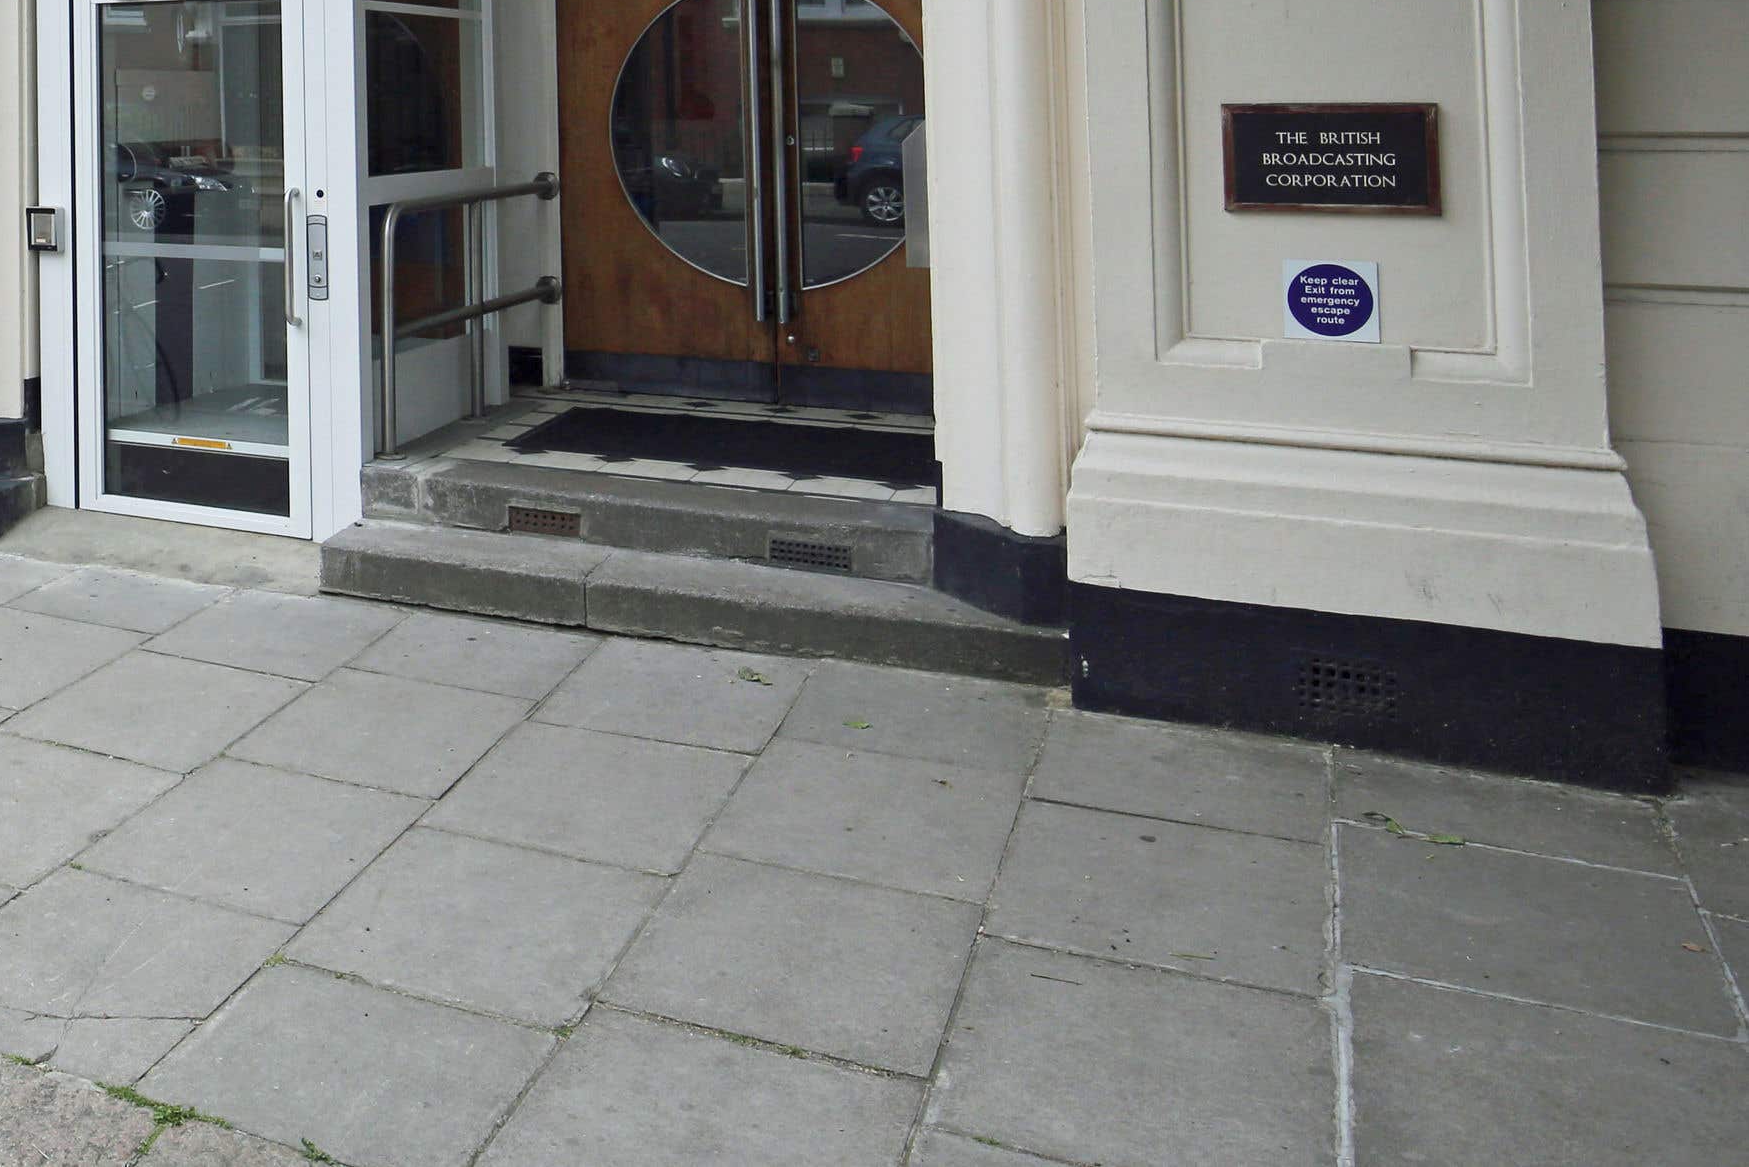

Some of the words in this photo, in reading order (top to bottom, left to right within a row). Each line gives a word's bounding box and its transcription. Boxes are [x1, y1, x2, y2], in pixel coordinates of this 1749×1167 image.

[1275, 132, 1308, 144] THE
[1319, 132, 1380, 145] BRITISH
[1262, 153, 1396, 166] BROADCASTING
[1266, 174, 1396, 187] CORPORATION
[1300, 275, 1327, 285] Keep
[1332, 277, 1359, 285] clear
[1305, 285, 1325, 294] Exit
[1329, 287, 1355, 295] from
[1300, 296, 1360, 307] emergency
[1311, 306, 1350, 316] escape
[1316, 316, 1345, 325] route
